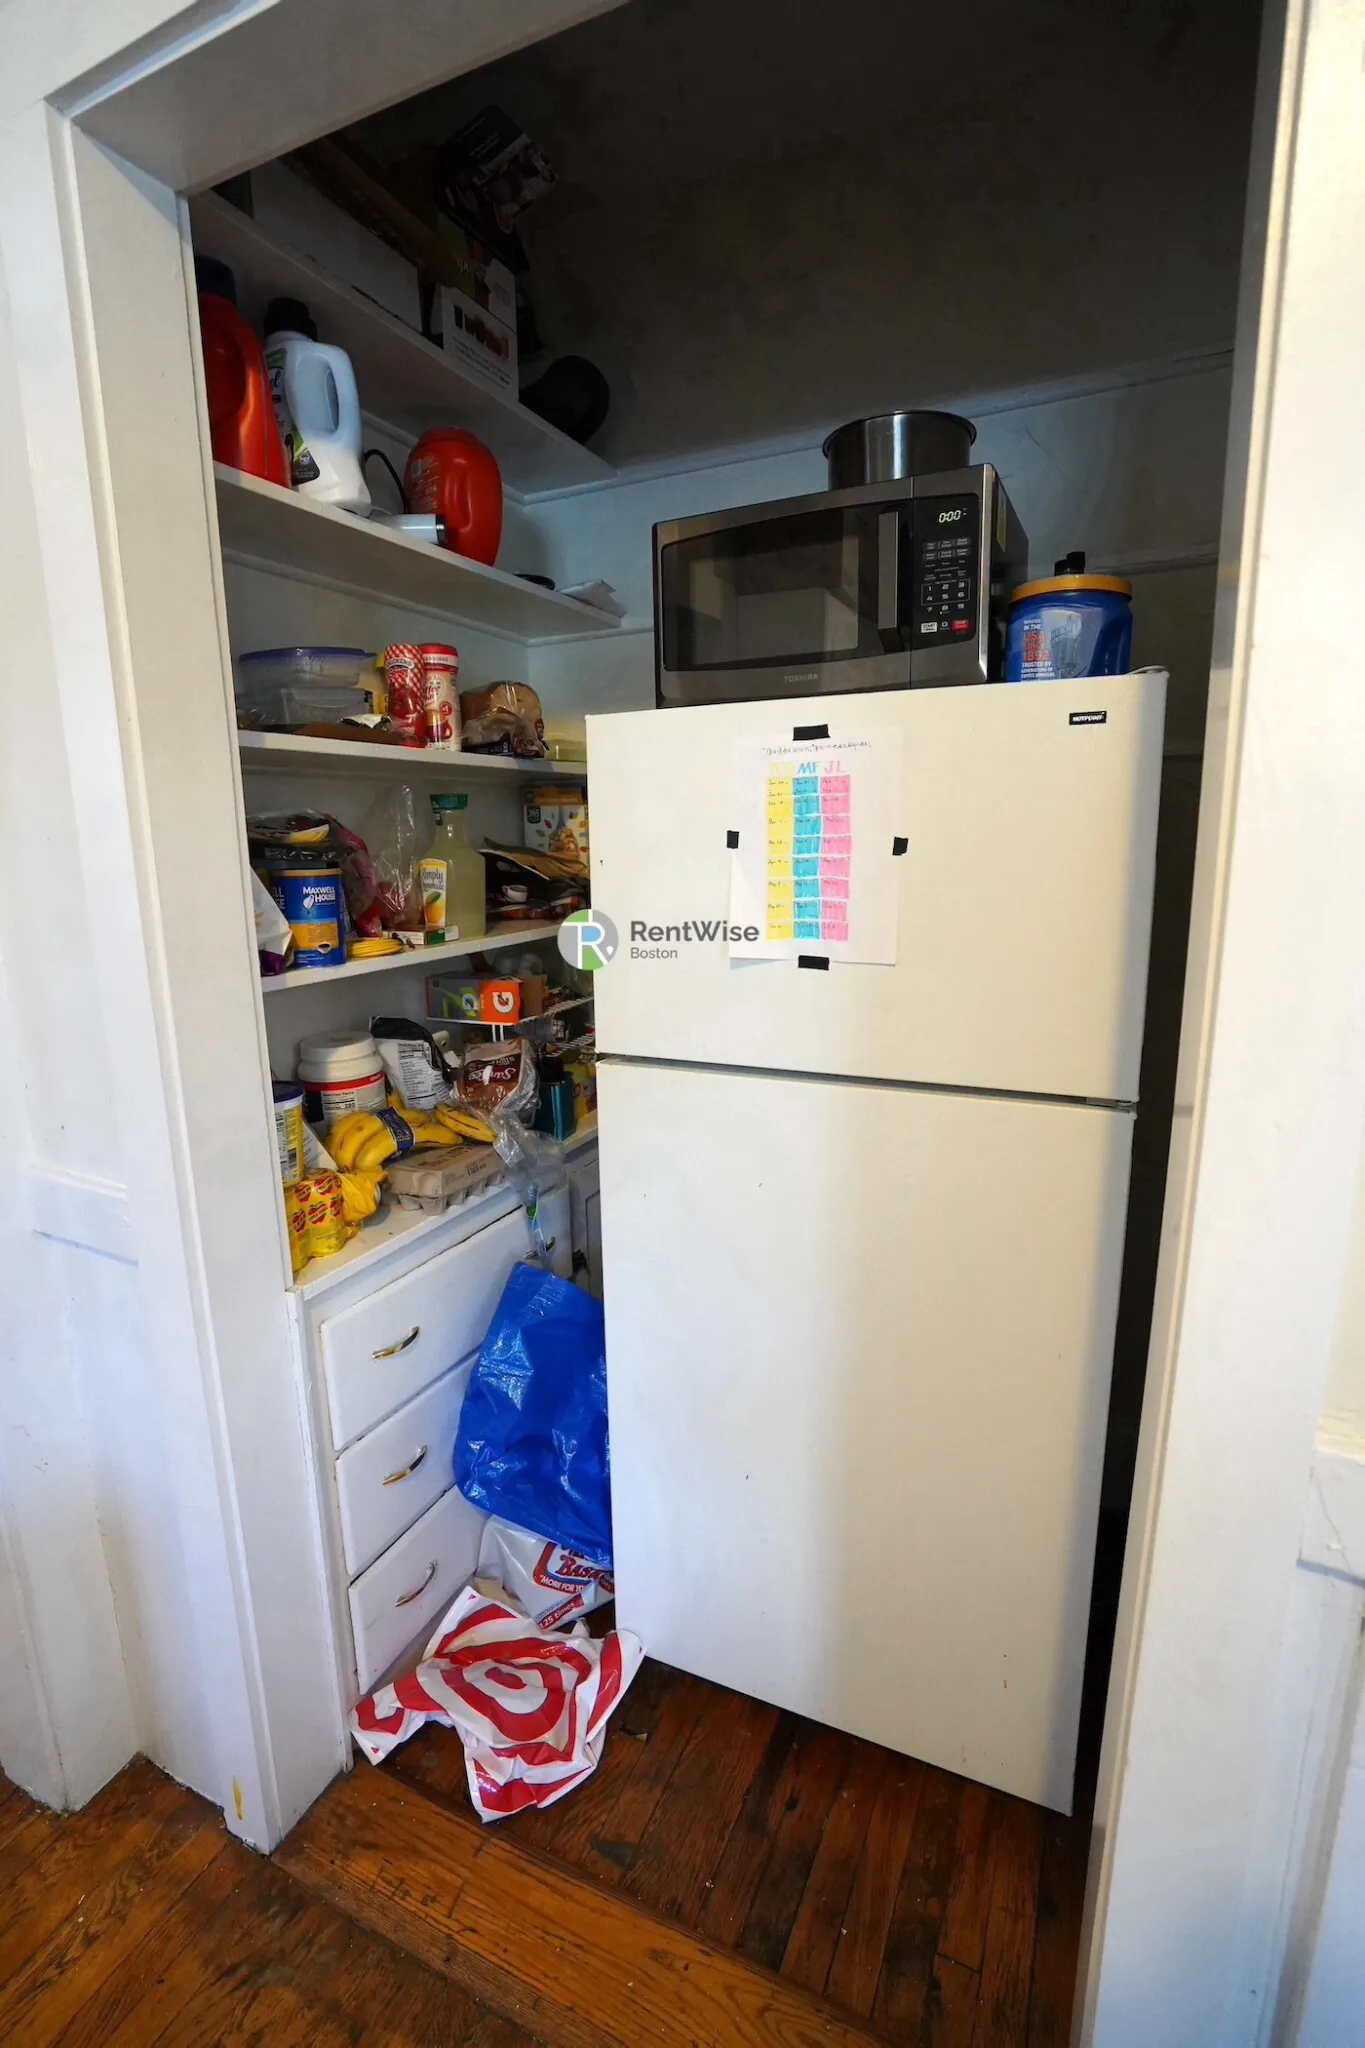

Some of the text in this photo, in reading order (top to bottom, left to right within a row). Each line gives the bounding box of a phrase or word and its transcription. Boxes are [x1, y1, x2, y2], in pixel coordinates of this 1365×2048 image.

[939, 510, 961, 523] 0:00
[1023, 631, 1047, 641] USA
[1023, 650, 1051, 661] 1892
[797, 761, 820, 774] MF
[303, 886, 335, 895] MAXWELL
[315, 893, 336, 903] HOUSE
[492, 991, 514, 1014] G
[561, 1582, 575, 1592] FOR
